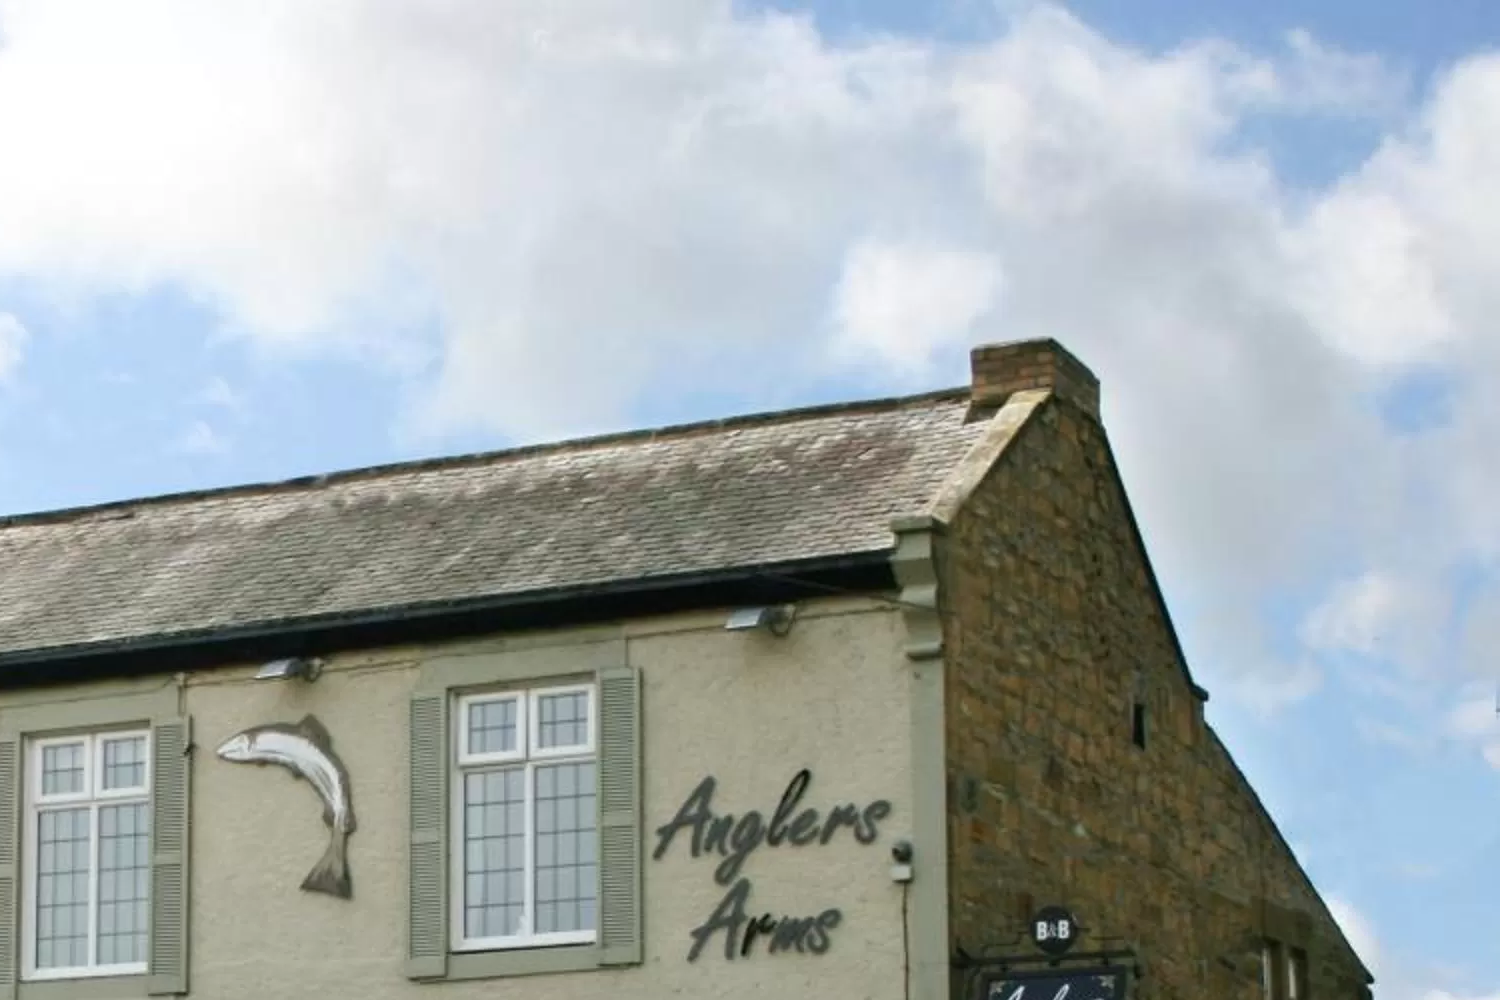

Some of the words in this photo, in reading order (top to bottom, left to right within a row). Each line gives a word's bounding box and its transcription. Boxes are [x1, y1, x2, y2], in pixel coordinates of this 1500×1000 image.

[652, 769, 892, 885] Anglers
[687, 877, 842, 962] Arms
[1036, 919, 1070, 940] B&B
